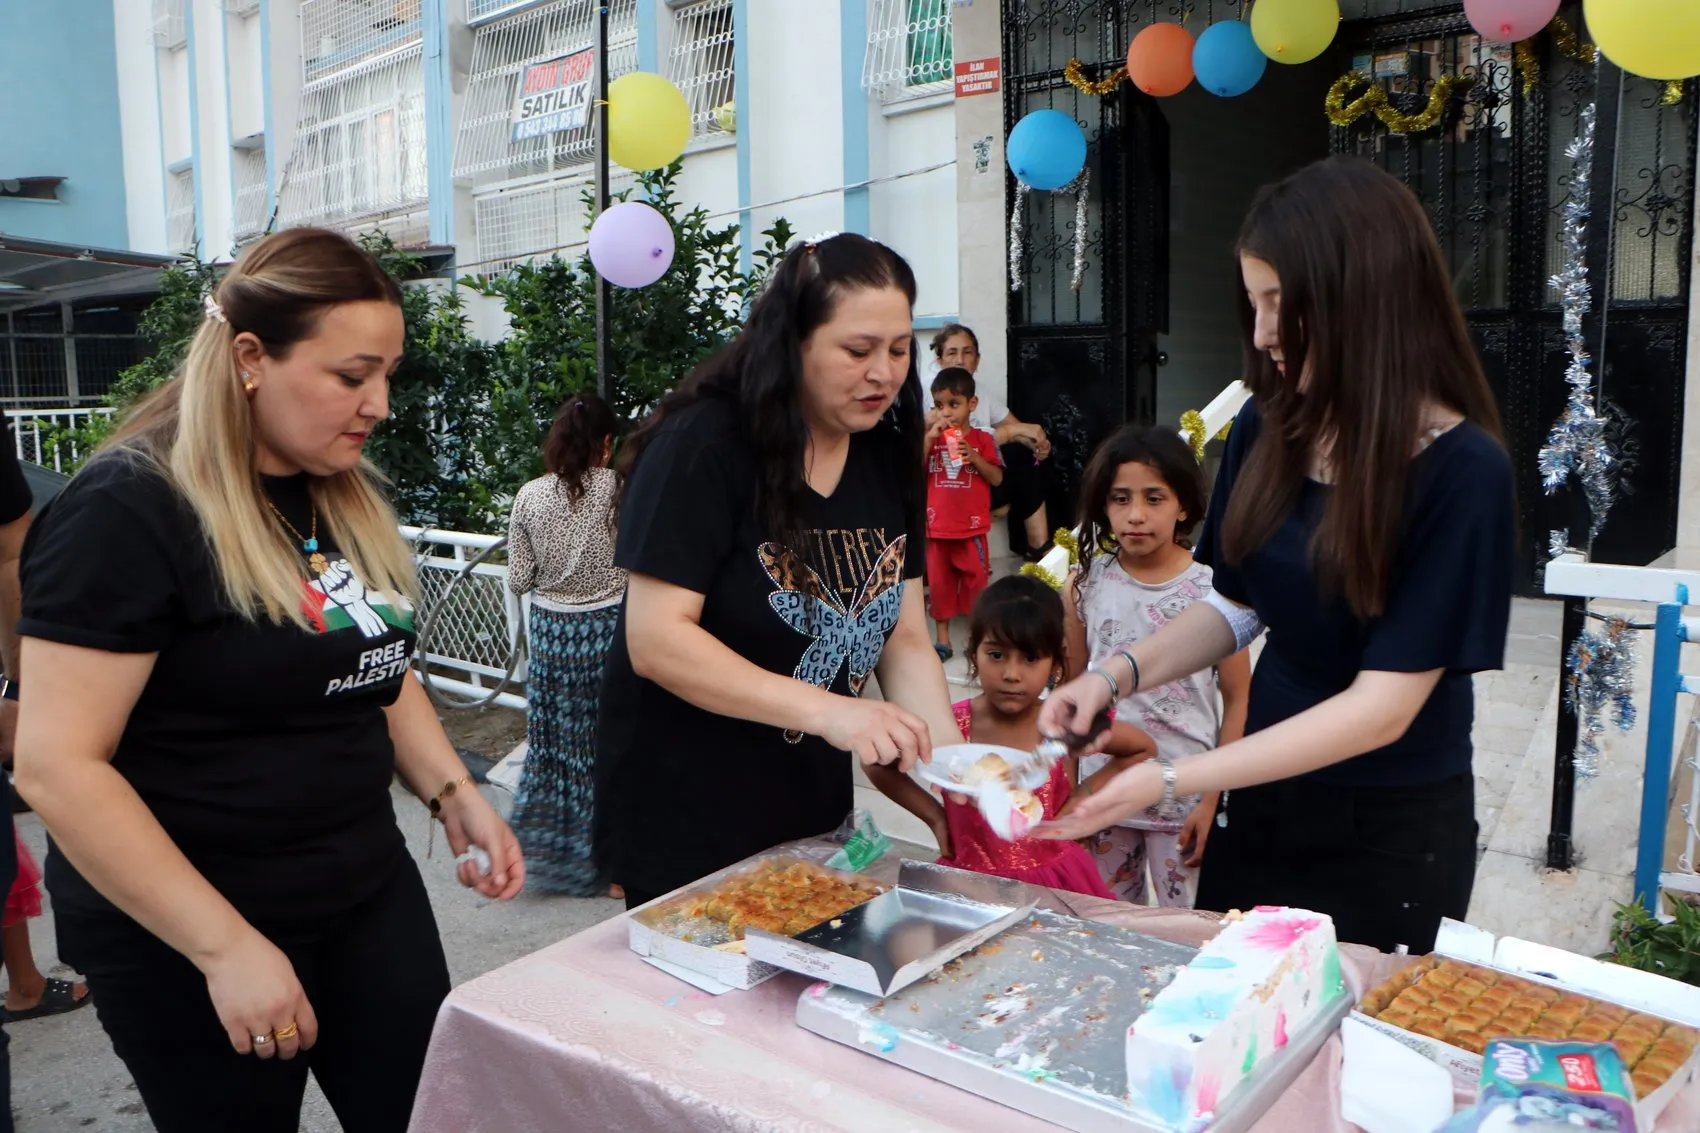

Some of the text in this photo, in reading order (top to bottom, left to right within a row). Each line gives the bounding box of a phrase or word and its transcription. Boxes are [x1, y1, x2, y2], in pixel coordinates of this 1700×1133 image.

[521, 82, 588, 119] SATILIK
[358, 639, 406, 670] FREE
[325, 656, 411, 696] PALESTIN
[1560, 1057, 1587, 1086] 250
